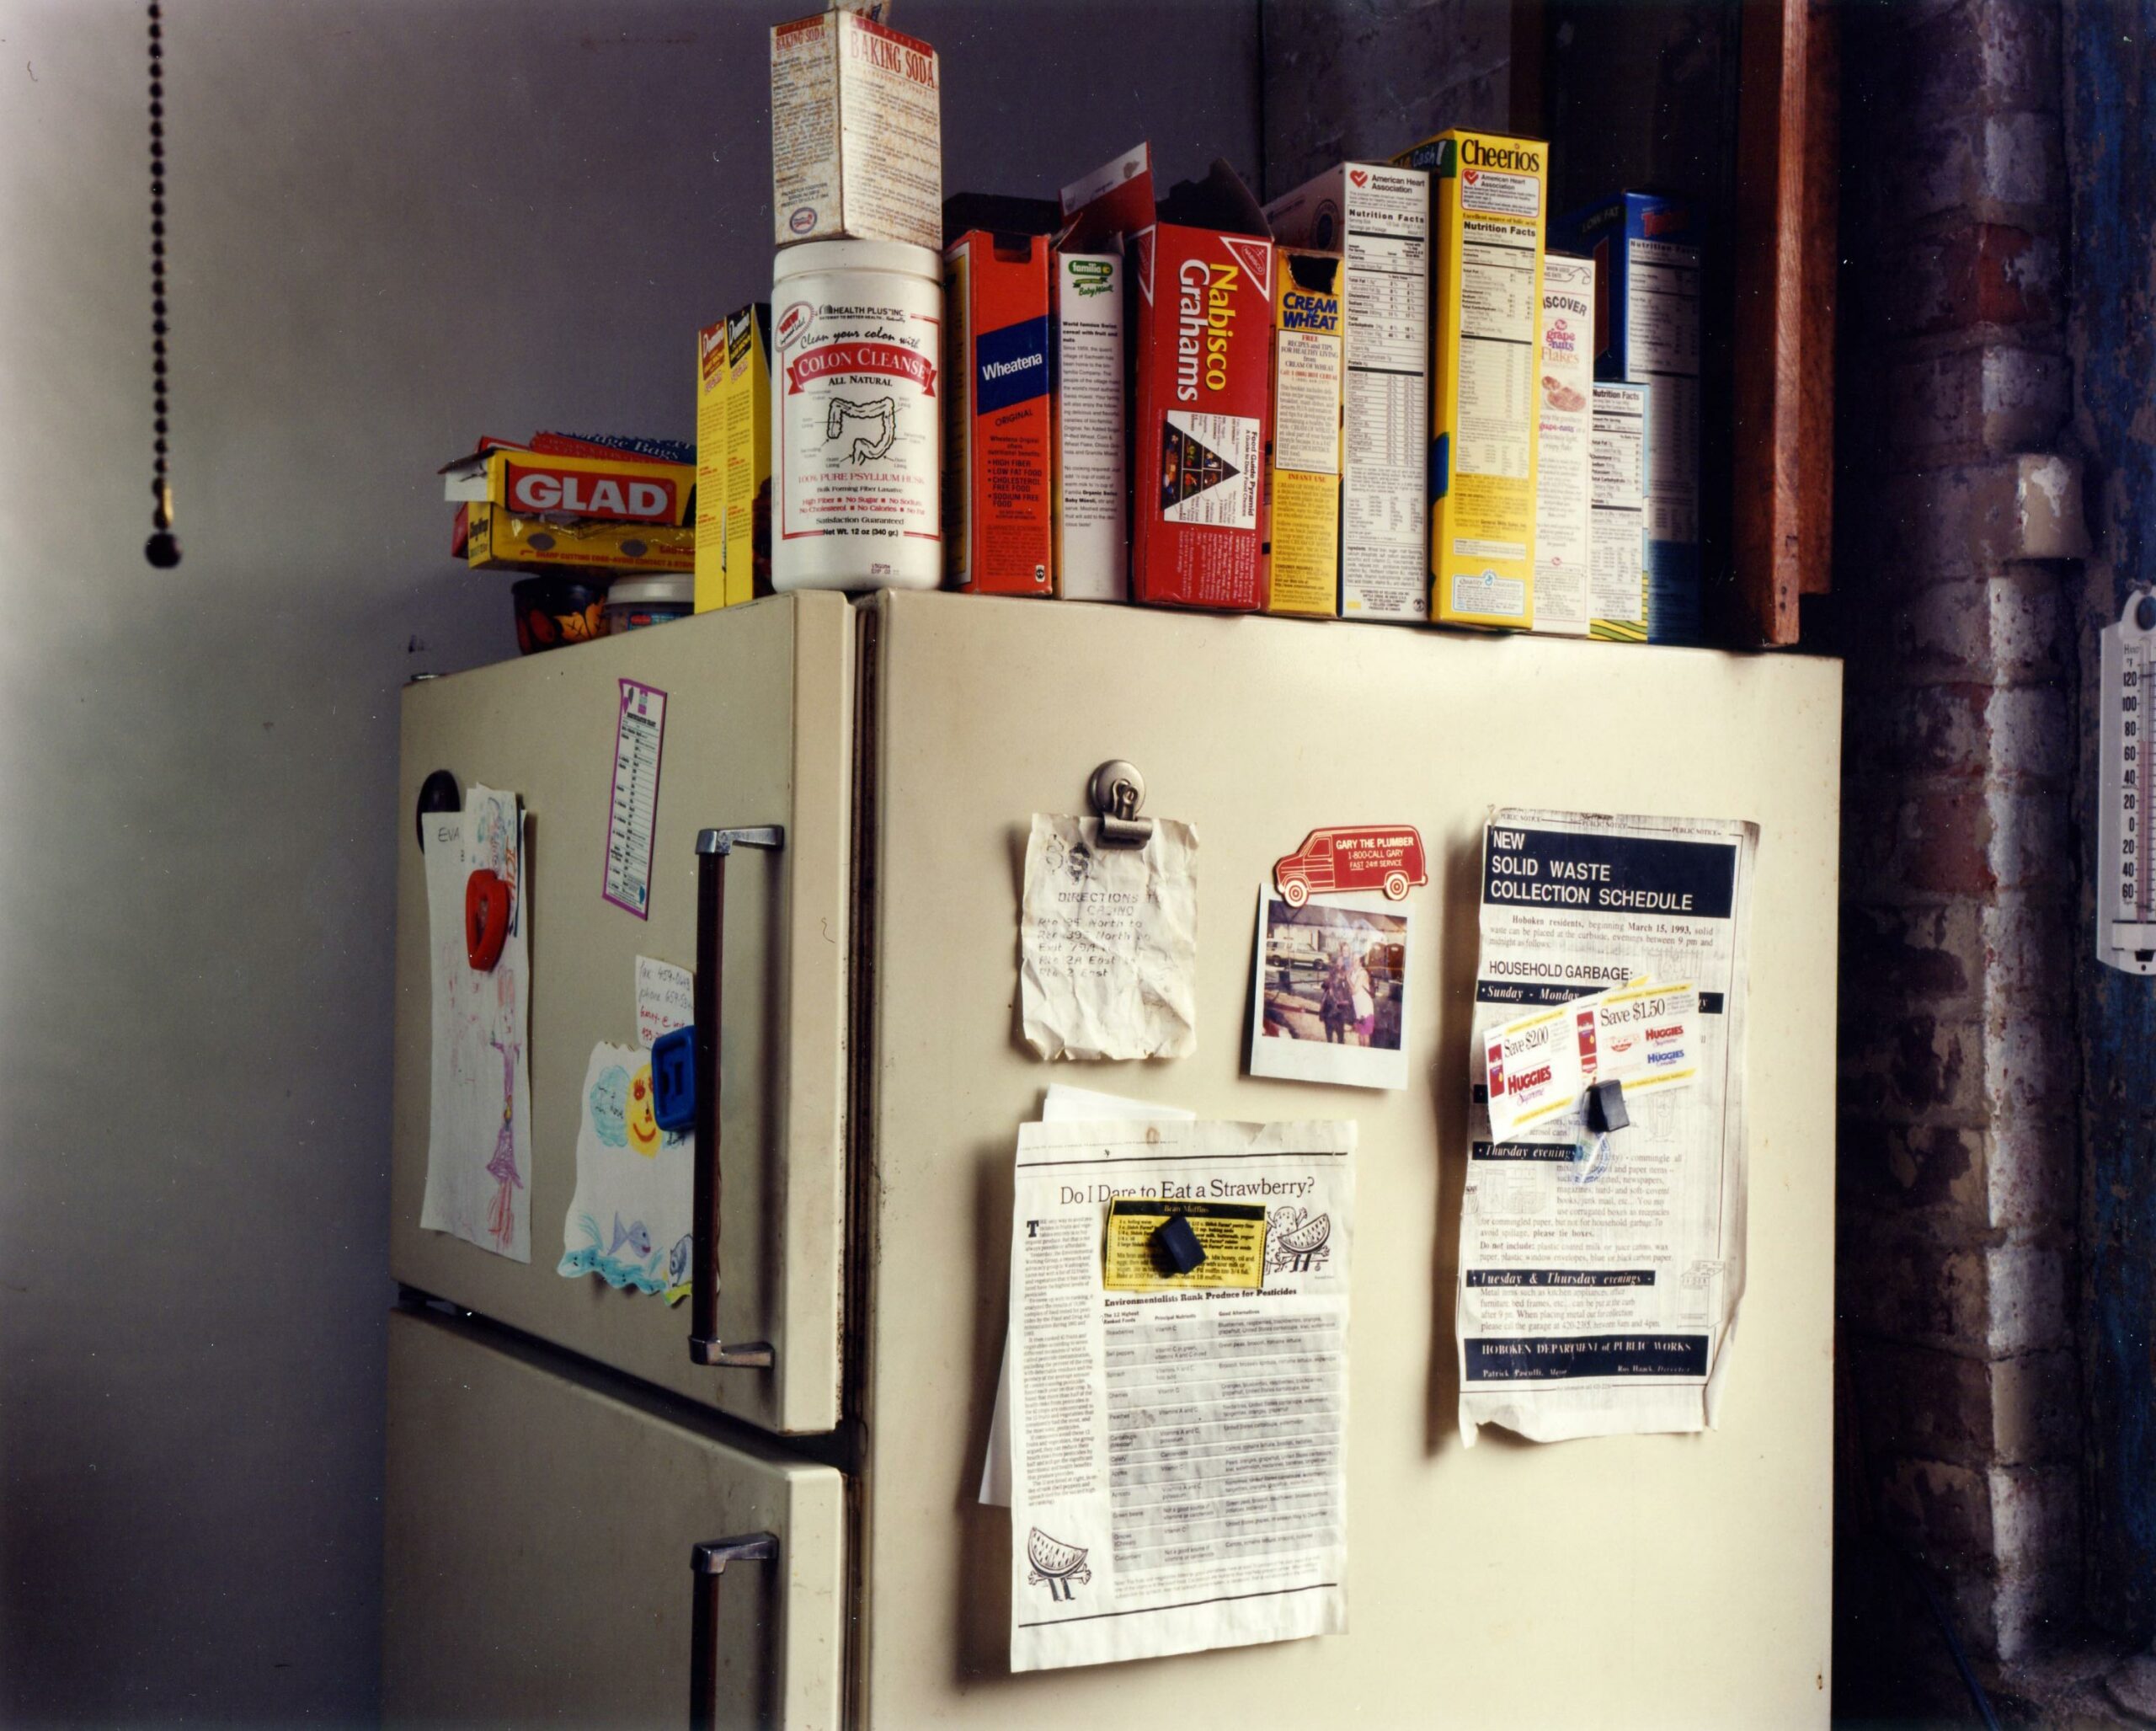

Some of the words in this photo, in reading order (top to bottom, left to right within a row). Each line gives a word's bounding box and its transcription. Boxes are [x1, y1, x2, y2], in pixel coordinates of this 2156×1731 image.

[776, 31, 803, 51] BAKING
[805, 28, 825, 43] SODA
[851, 30, 901, 73] BAKING
[905, 50, 935, 89] SODA
[1461, 139, 1540, 172] Cheerios
[1372, 174, 1405, 184] American
[1406, 178, 1425, 187] Heart
[1481, 174, 1508, 183] American
[1481, 181, 1515, 190] Association
[1372, 183, 1412, 194] Association
[1349, 209, 1393, 221] Nutrition
[1398, 214, 1424, 223] Facts
[1464, 222, 1507, 233] Nutrition
[1511, 227, 1535, 237] Facts
[1630, 240, 1673, 252] Nutrition
[1073, 261, 1102, 273] familia
[1242, 246, 1264, 274] NABISCO
[833, 306, 865, 314] HEALTH
[867, 306, 888, 315] PLUS
[1283, 292, 1338, 314] CREAM
[779, 307, 799, 334] NEW
[1206, 263, 1239, 390] Nabisco
[1283, 310, 1338, 330] WHEAT
[1177, 259, 1210, 401] Grahams
[1546, 329, 1577, 344] grape
[800, 334, 830, 350] Clean
[833, 331, 860, 345] your
[864, 326, 895, 341] colon
[899, 336, 920, 349] with
[1541, 346, 1580, 364] Flakes
[798, 351, 851, 377] COLON
[857, 348, 927, 379] CLEANSE
[982, 353, 1043, 381] Wheatena
[829, 377, 846, 387] ALL
[850, 375, 893, 387] NATURAL
[1593, 389, 1621, 399] Nutrition
[1622, 392, 1640, 401] Facts
[995, 409, 1033, 426] ORIGINAL
[633, 441, 680, 460] Bags
[820, 473, 847, 481] PURE
[850, 473, 900, 482] PSYLLIUM
[515, 473, 668, 517] GLAD
[1247, 481, 1256, 516] Pyramid
[816, 516, 859, 525] Satisfaction
[861, 516, 905, 526] Guaranteed
[872, 528, 887, 537] (340
[2123, 673, 2137, 686] 120
[2122, 696, 2137, 711] 100
[2124, 722, 2137, 736] 80
[2124, 746, 2136, 761] 60
[2124, 771, 2135, 784] 40
[2123, 795, 2135, 809] 20
[2129, 818, 2135, 831] 0
[438, 826, 460, 842] EVA
[1493, 831, 1525, 850] NEW
[1336, 840, 1358, 850] GARY
[1359, 838, 1375, 848] THE
[1377, 836, 1414, 847] PLUMBER
[2122, 840, 2134, 853] 20
[1386, 849, 1404, 857] GARY
[1350, 861, 1364, 870] FAST
[1380, 859, 1402, 868] SERVICE
[1492, 856, 1539, 876] SOLID
[1550, 860, 1611, 882] WASTE
[2122, 863, 2134, 877] 40
[1058, 893, 1138, 903] DIRECTIONS
[1491, 881, 1590, 905] COLLECTION
[1599, 889, 1693, 911] SCHEDULE
[2122, 884, 2134, 898] 60
[1513, 916, 1545, 926] Hoboken
[1550, 918, 1584, 928] residents,
[1628, 922, 1652, 932] March
[1657, 924, 1668, 934] 15,
[1671, 925, 1692, 935] 1993,
[1694, 927, 1713, 936] solid
[1686, 938, 1698, 948] pm
[1700, 937, 1713, 946] and
[1490, 961, 1562, 977] HOUSEHOLD
[1566, 964, 1633, 980] GARBAGE:
[1487, 985, 1524, 1001] Sunday
[1540, 988, 1579, 1002] Monday
[1600, 1007, 1630, 1027] Save
[1632, 998, 1666, 1021] $1.50
[1646, 1025, 1684, 1041] HUGGIES
[1504, 1039, 1525, 1058] Save
[1647, 1050, 1684, 1064] HUGGIES
[1508, 1065, 1552, 1095] HUGGIES
[1486, 1144, 1530, 1160] Thursday
[1060, 1186, 1084, 1205] Do
[1088, 1185, 1093, 1204] I
[1098, 1184, 1136, 1203] Dare
[1140, 1184, 1156, 1199] to
[1161, 1181, 1192, 1199] Eat
[1195, 1184, 1206, 1198] a
[1210, 1177, 1315, 1199] Strawberry?
[1533, 1229, 1556, 1239] please
[1529, 1274, 1539, 1285] &
[1547, 1272, 1597, 1287] Thursday
[1604, 1274, 1641, 1286] evenings
[1105, 1295, 1178, 1307] Environmentalists
[1181, 1293, 1203, 1302] Rank
[1205, 1290, 1240, 1301] Produce
[1242, 1290, 1254, 1298] for
[1257, 1288, 1297, 1297] Pesticides
[1482, 1344, 1532, 1354] HOBOKEN
[1537, 1341, 1598, 1354] DEPARTMENT
[1483, 1369, 1509, 1378] Patrick
